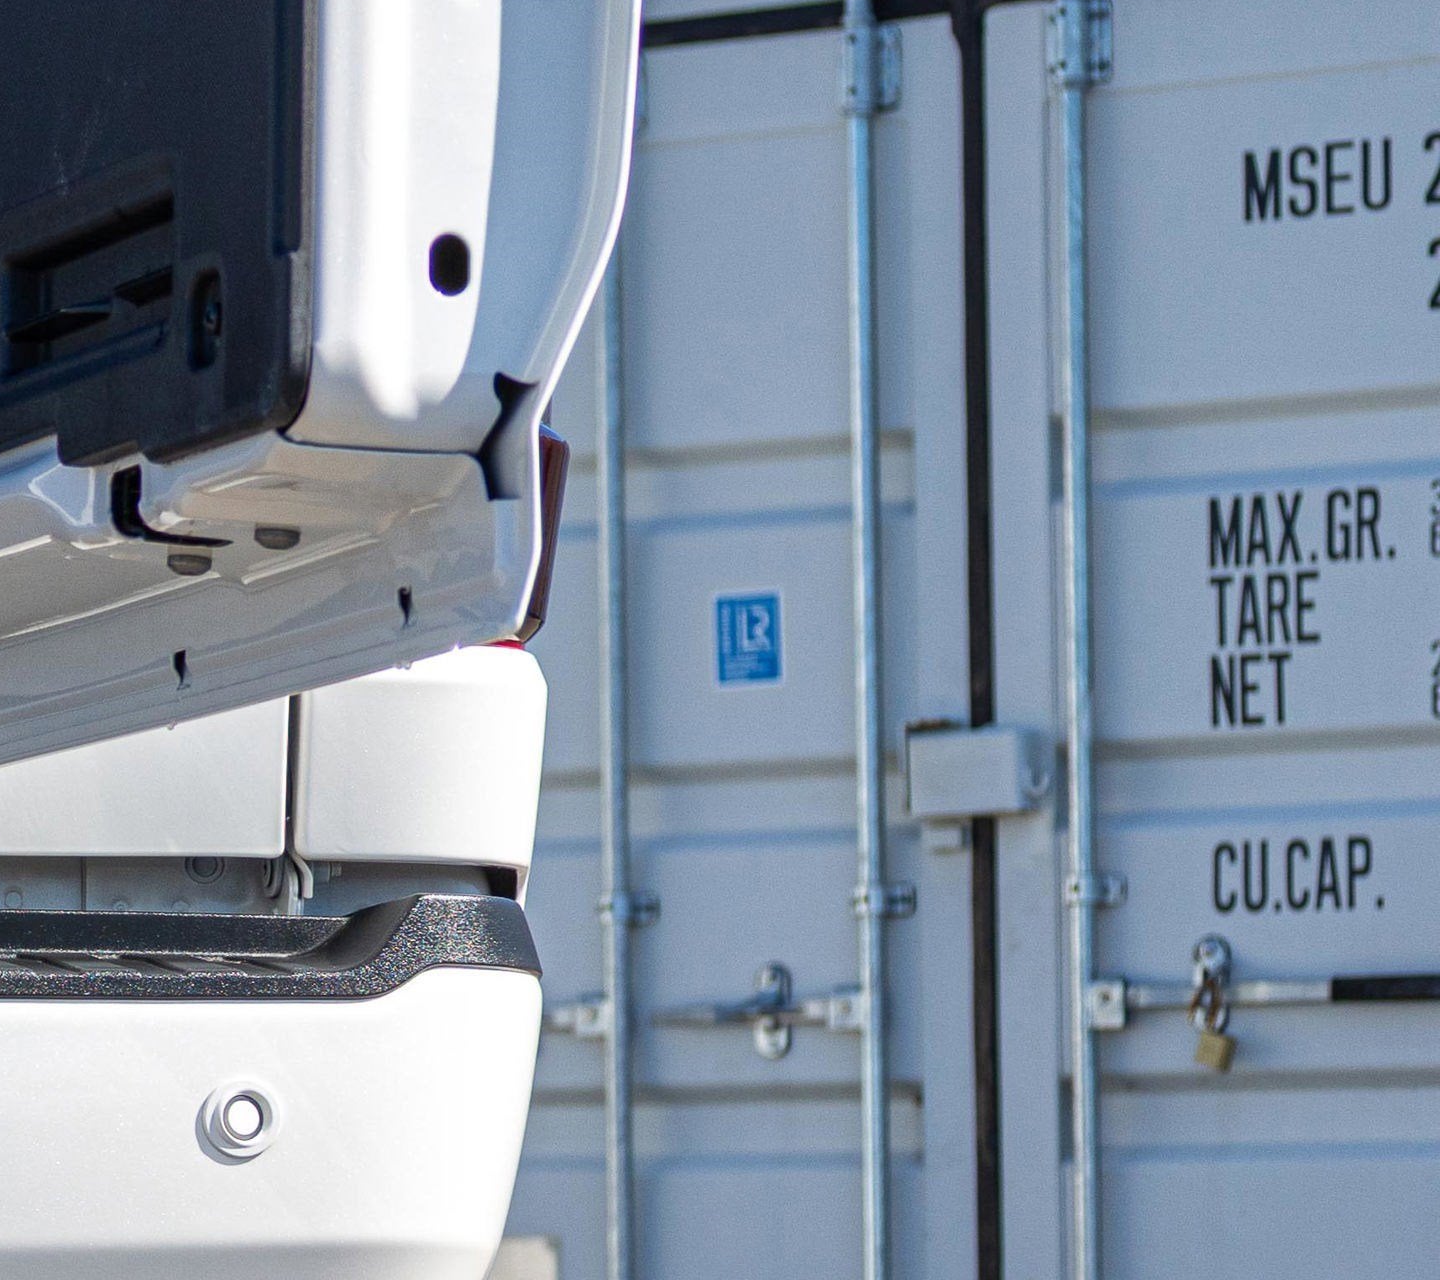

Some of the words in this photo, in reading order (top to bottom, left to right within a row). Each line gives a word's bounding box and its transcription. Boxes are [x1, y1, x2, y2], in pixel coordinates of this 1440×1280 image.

[1245, 137, 1391, 222] MSEU
[1209, 487, 1395, 568] MAX.GR.
[1209, 571, 1321, 648] TARE
[1210, 652, 1292, 727] NET
[1213, 836, 1385, 914] CU.CAP.
